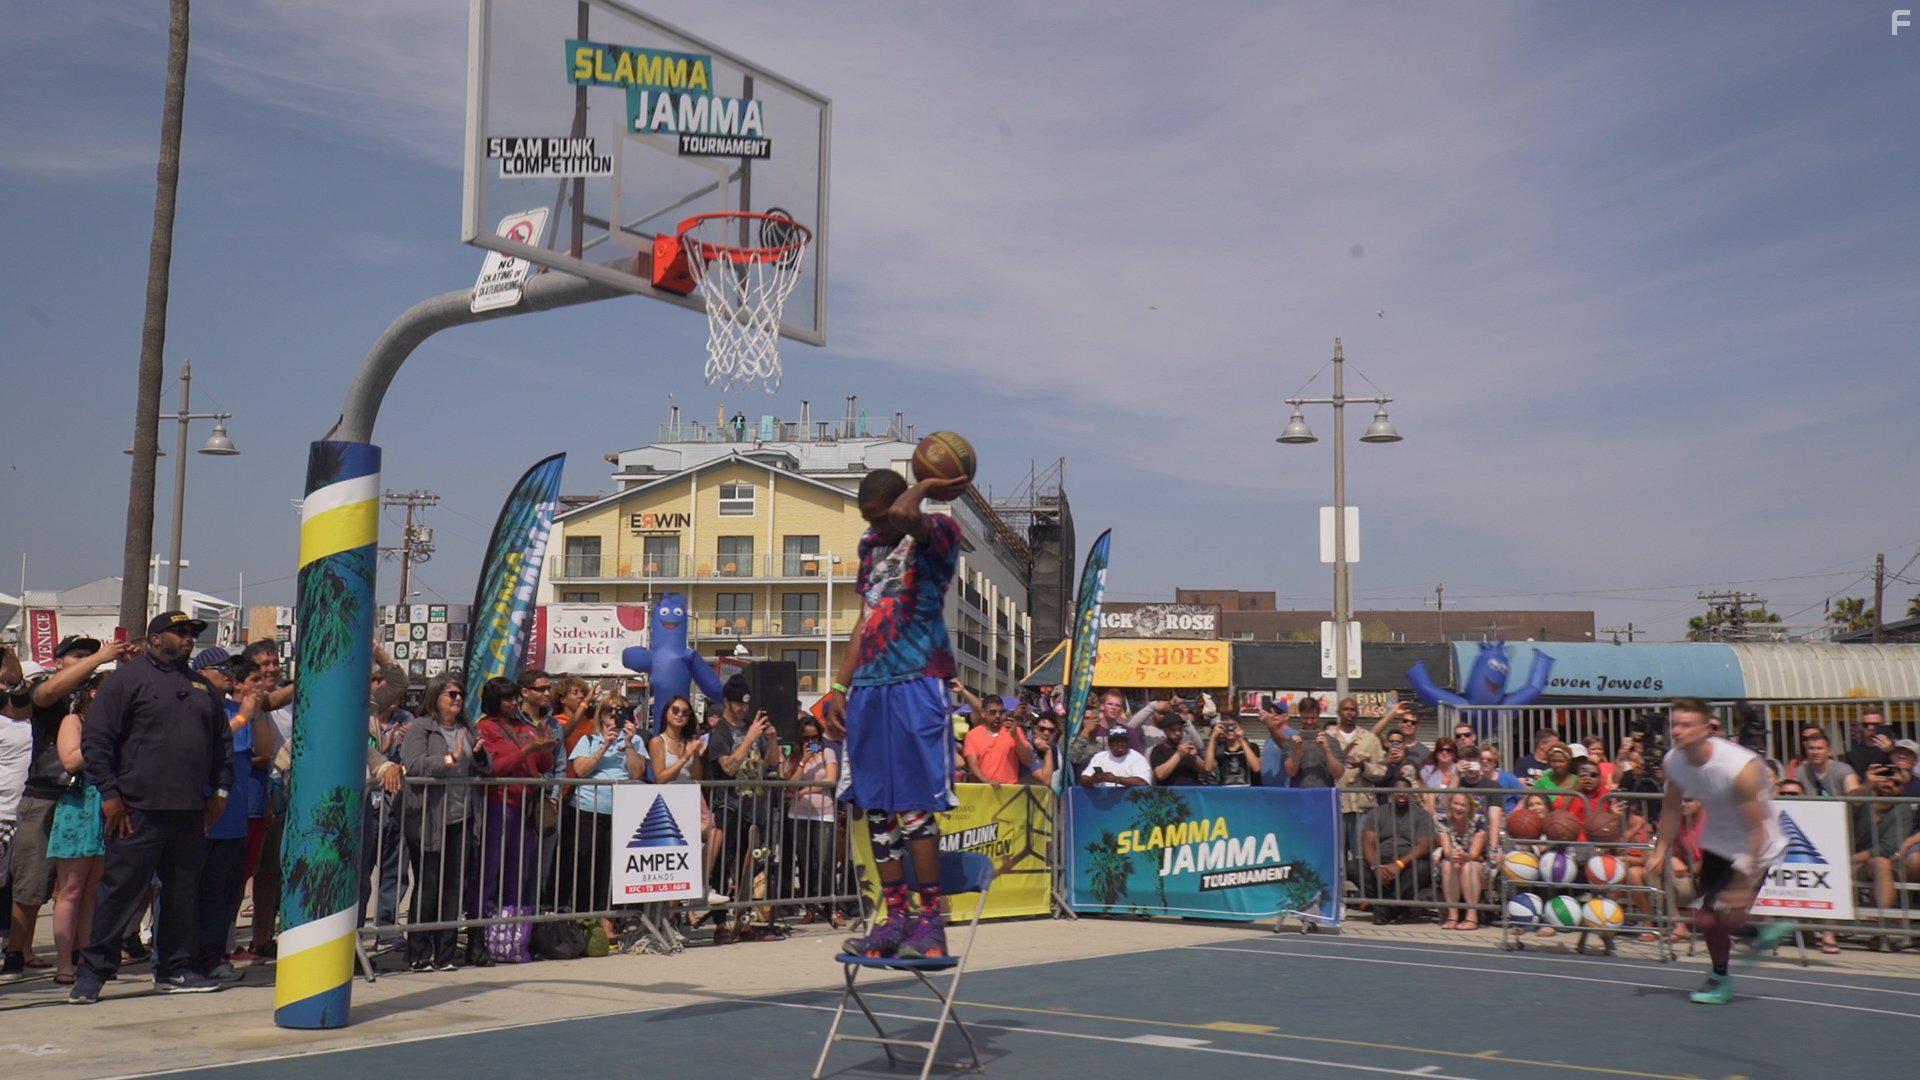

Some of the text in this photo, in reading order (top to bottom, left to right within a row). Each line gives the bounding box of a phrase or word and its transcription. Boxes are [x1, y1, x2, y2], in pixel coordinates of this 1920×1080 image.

[575, 47, 708, 90] SLAMMA
[635, 90, 764, 136] JAMMA
[490, 138, 593, 158] SLAM DUNK
[682, 136, 768, 156] TOURNAMENT
[503, 156, 612, 174] COMPETITION
[498, 259, 515, 270] NO
[631, 513, 691, 528] ERWIN
[1166, 613, 1215, 631] ROSE
[36, 613, 53, 664] VENICE
[553, 626, 626, 639] Sidewalk
[552, 642, 611, 655] Market
[1137, 647, 1220, 666] SHOES
[1548, 675, 1664, 691] even Jewels
[1356, 693, 1387, 704] FISH
[1359, 705, 1387, 715] TACO
[939, 823, 998, 852] AM DUNK
[1117, 816, 1230, 855] SLAMMA
[625, 852, 690, 873] AMPEX
[1159, 832, 1281, 878] JAMMA
[642, 873, 675, 882] BRANDS
[1203, 865, 1292, 889] TOURNAMENT
